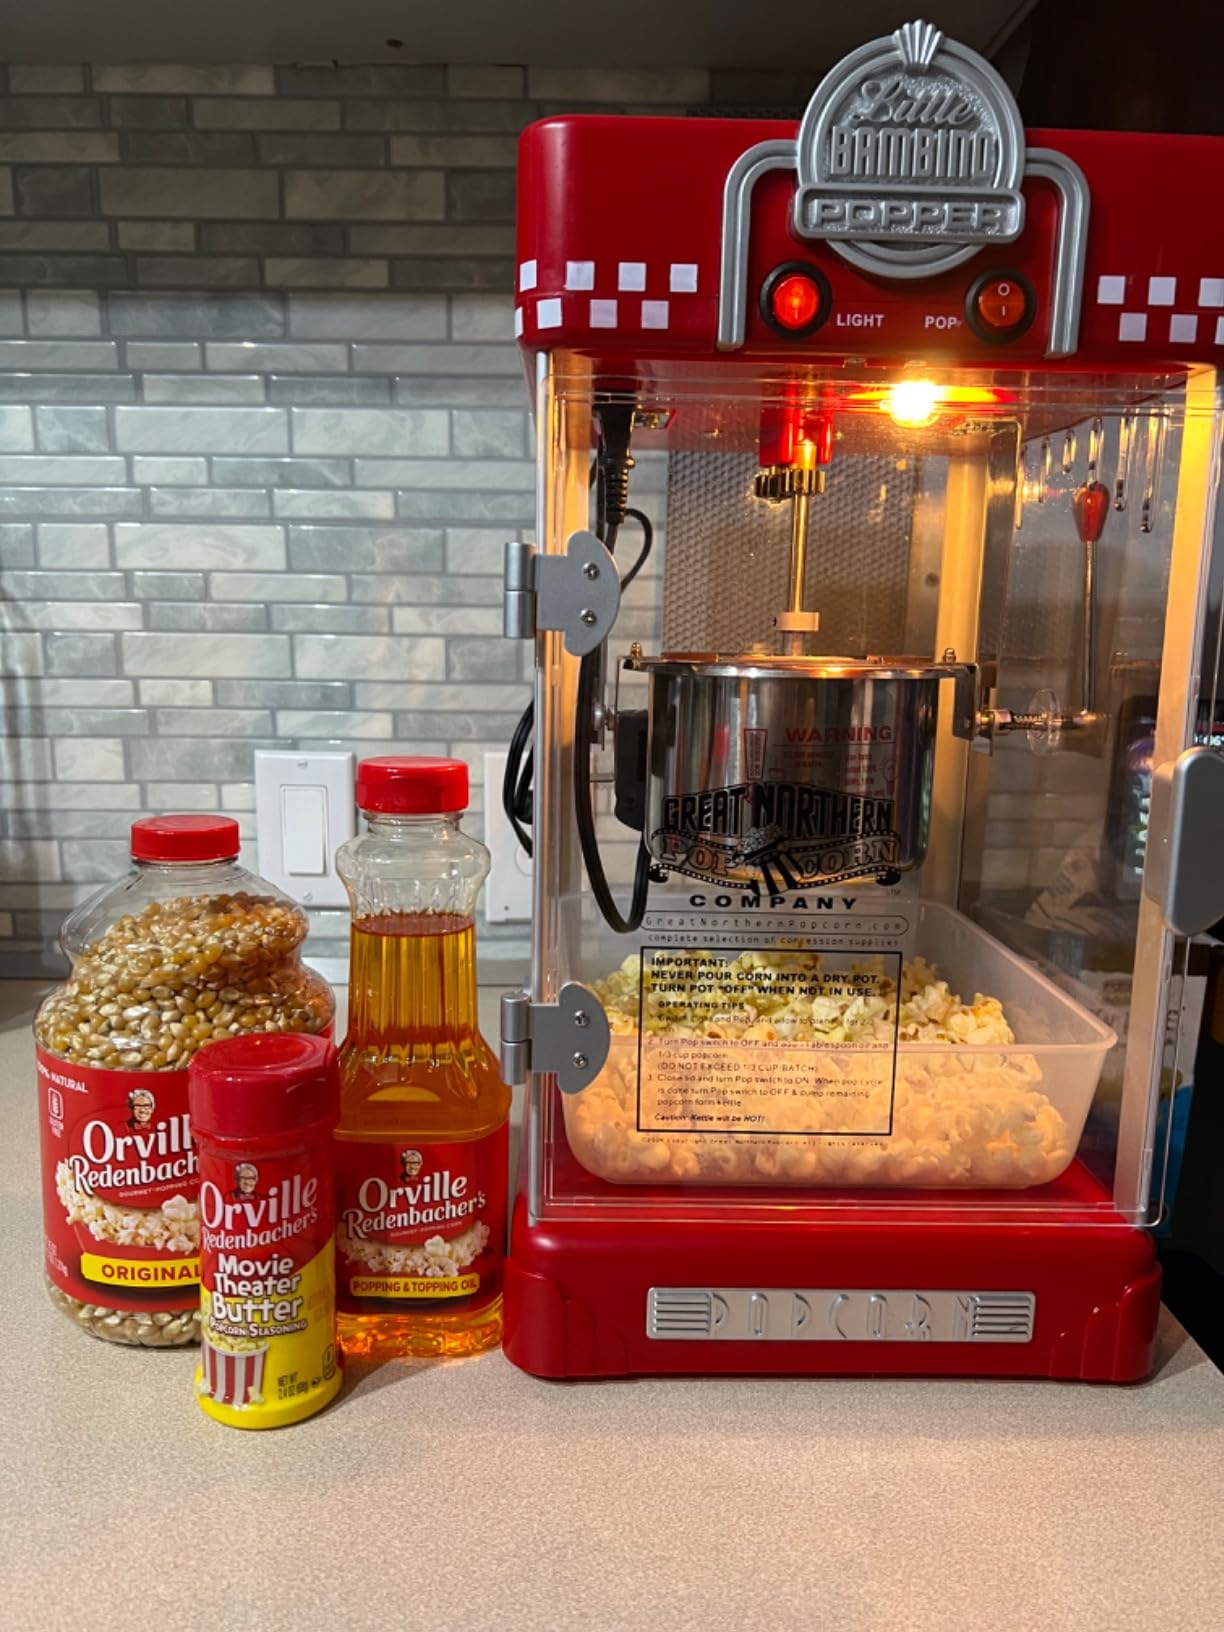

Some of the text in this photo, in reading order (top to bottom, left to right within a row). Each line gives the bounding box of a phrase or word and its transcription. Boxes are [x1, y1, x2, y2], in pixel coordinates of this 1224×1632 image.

[850, 79, 978, 125] Little
[830, 126, 994, 178] BAMBINO
[813, 199, 1004, 235] POPPER
[836, 314, 885, 328] LIGHT
[924, 316, 958, 330] POP
[785, 726, 892, 743] WARNING
[663, 782, 894, 838] GREAT NORTHERN
[689, 894, 857, 910] COMPANY
[651, 957, 729, 968] IMPORTANT:
[651, 970, 880, 985] NEVER POUR CORN INTO A DRY POT.
[651, 983, 876, 997] TURN POT "OFF" WHEN NOT IN USE.
[658, 1001, 745, 1012] OPERATING TIPS
[658, 1038, 678, 1046] Turn
[680, 1038, 699, 1048] Pop
[740, 1040, 761, 1048] OFF
[679, 1062, 698, 1071] NOT
[701, 1063, 740, 1072] EXCEED
[758, 1064, 779, 1072] CUP
[51, 1072, 89, 1094] NATURAL
[657, 1073, 683, 1082] Close
[698, 1074, 714, 1082] and
[735, 1076, 753, 1085] Pop
[814, 1077, 840, 1086] When
[667, 1085, 690, 1095] done
[710, 1086, 729, 1097] Pop
[769, 1088, 788, 1097] OFF
[690, 1113, 714, 1122] Kettle
[83, 1114, 193, 1164] Orvill
[69, 1153, 200, 1195] Redenbach
[358, 1170, 468, 1213] Orville
[201, 1174, 318, 1231] Orville
[342, 1190, 487, 1240] Redenbacher's
[202, 1206, 318, 1253] Redenbacher's
[101, 1263, 200, 1282] ORIGINAL
[217, 1253, 294, 1277] Movie
[213, 1272, 302, 1298] Theater
[352, 1278, 477, 1293] POPPING & TOPPING OIL
[211, 1291, 304, 1323] Butter
